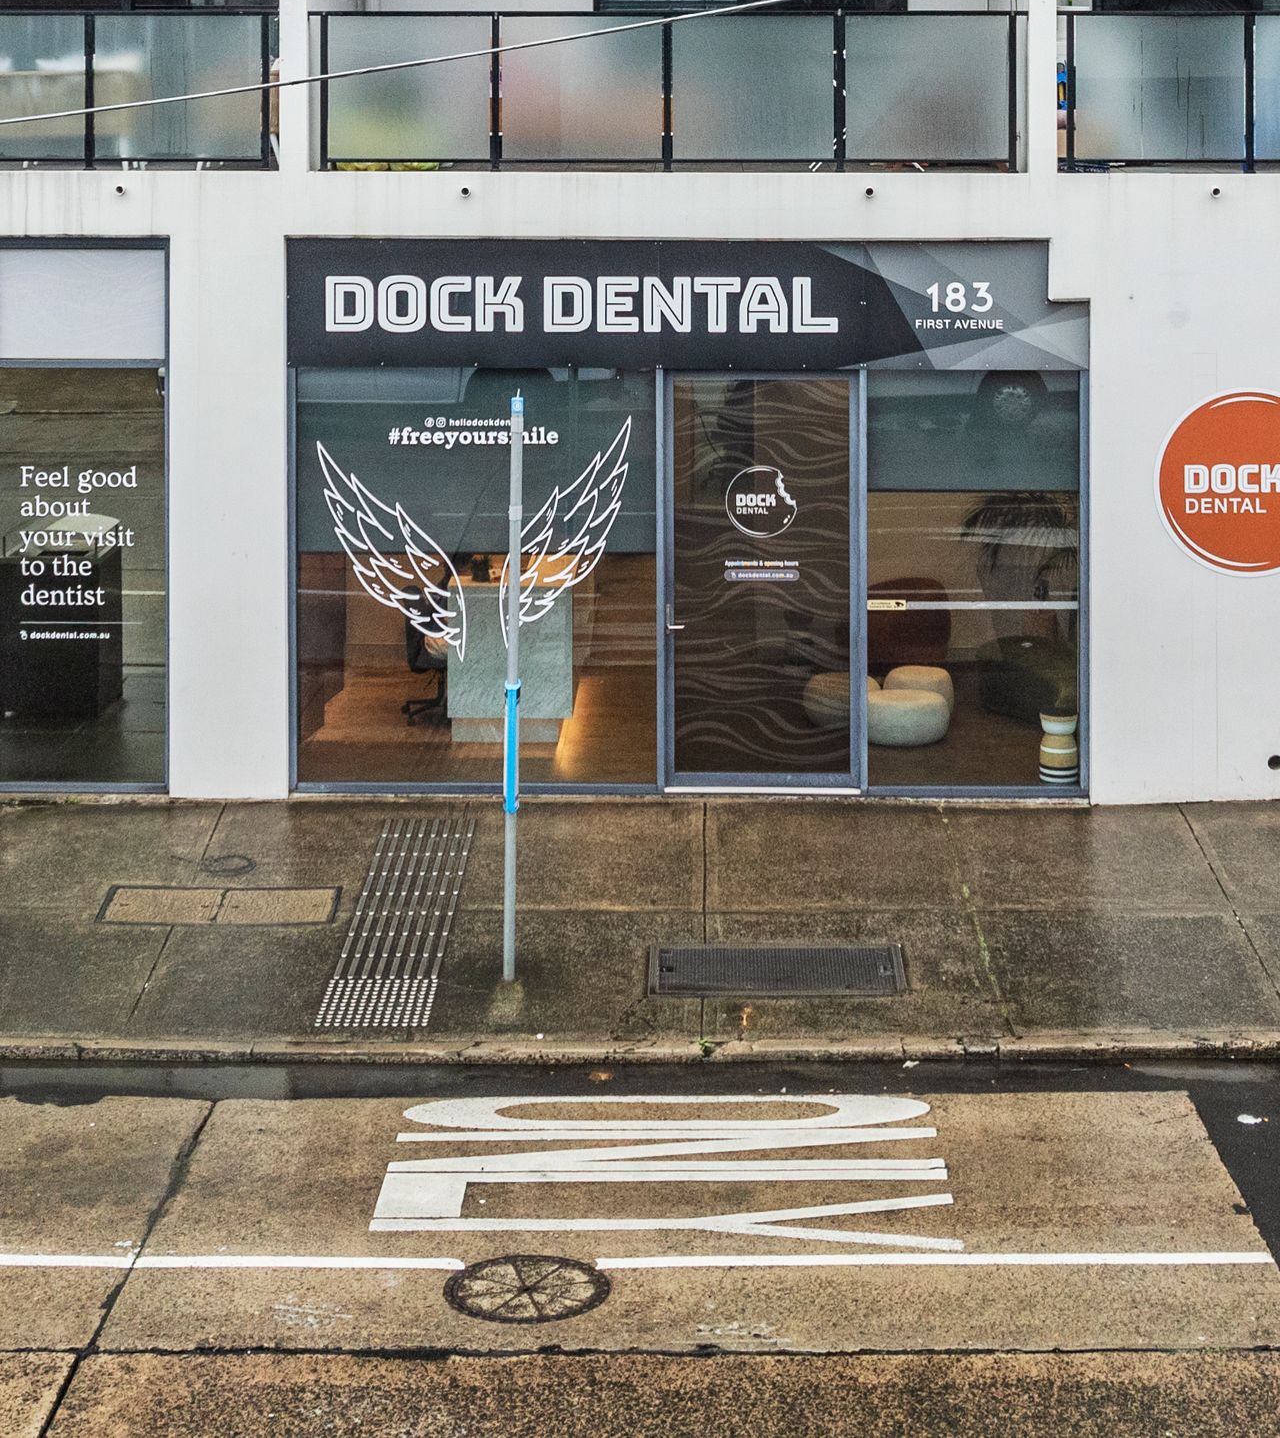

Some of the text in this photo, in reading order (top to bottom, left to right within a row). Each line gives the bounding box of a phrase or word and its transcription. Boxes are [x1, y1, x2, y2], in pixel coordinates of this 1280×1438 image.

[325, 276, 838, 333] DOCK DENTAL
[926, 282, 993, 312] 183
[915, 319, 1004, 330] FIRST AVENUE
[449, 417, 511, 427] hellodockden
[20, 466, 138, 493] Feel good
[20, 495, 91, 517] about
[736, 494, 776, 506] DOCK
[1185, 498, 1267, 514] DENTAL
[20, 526, 135, 552] your visit
[20, 554, 92, 576] to the
[21, 584, 105, 606] dentist
[30, 631, 111, 640] dockdental.com.au
[369, 1095, 964, 1251] ONLY
